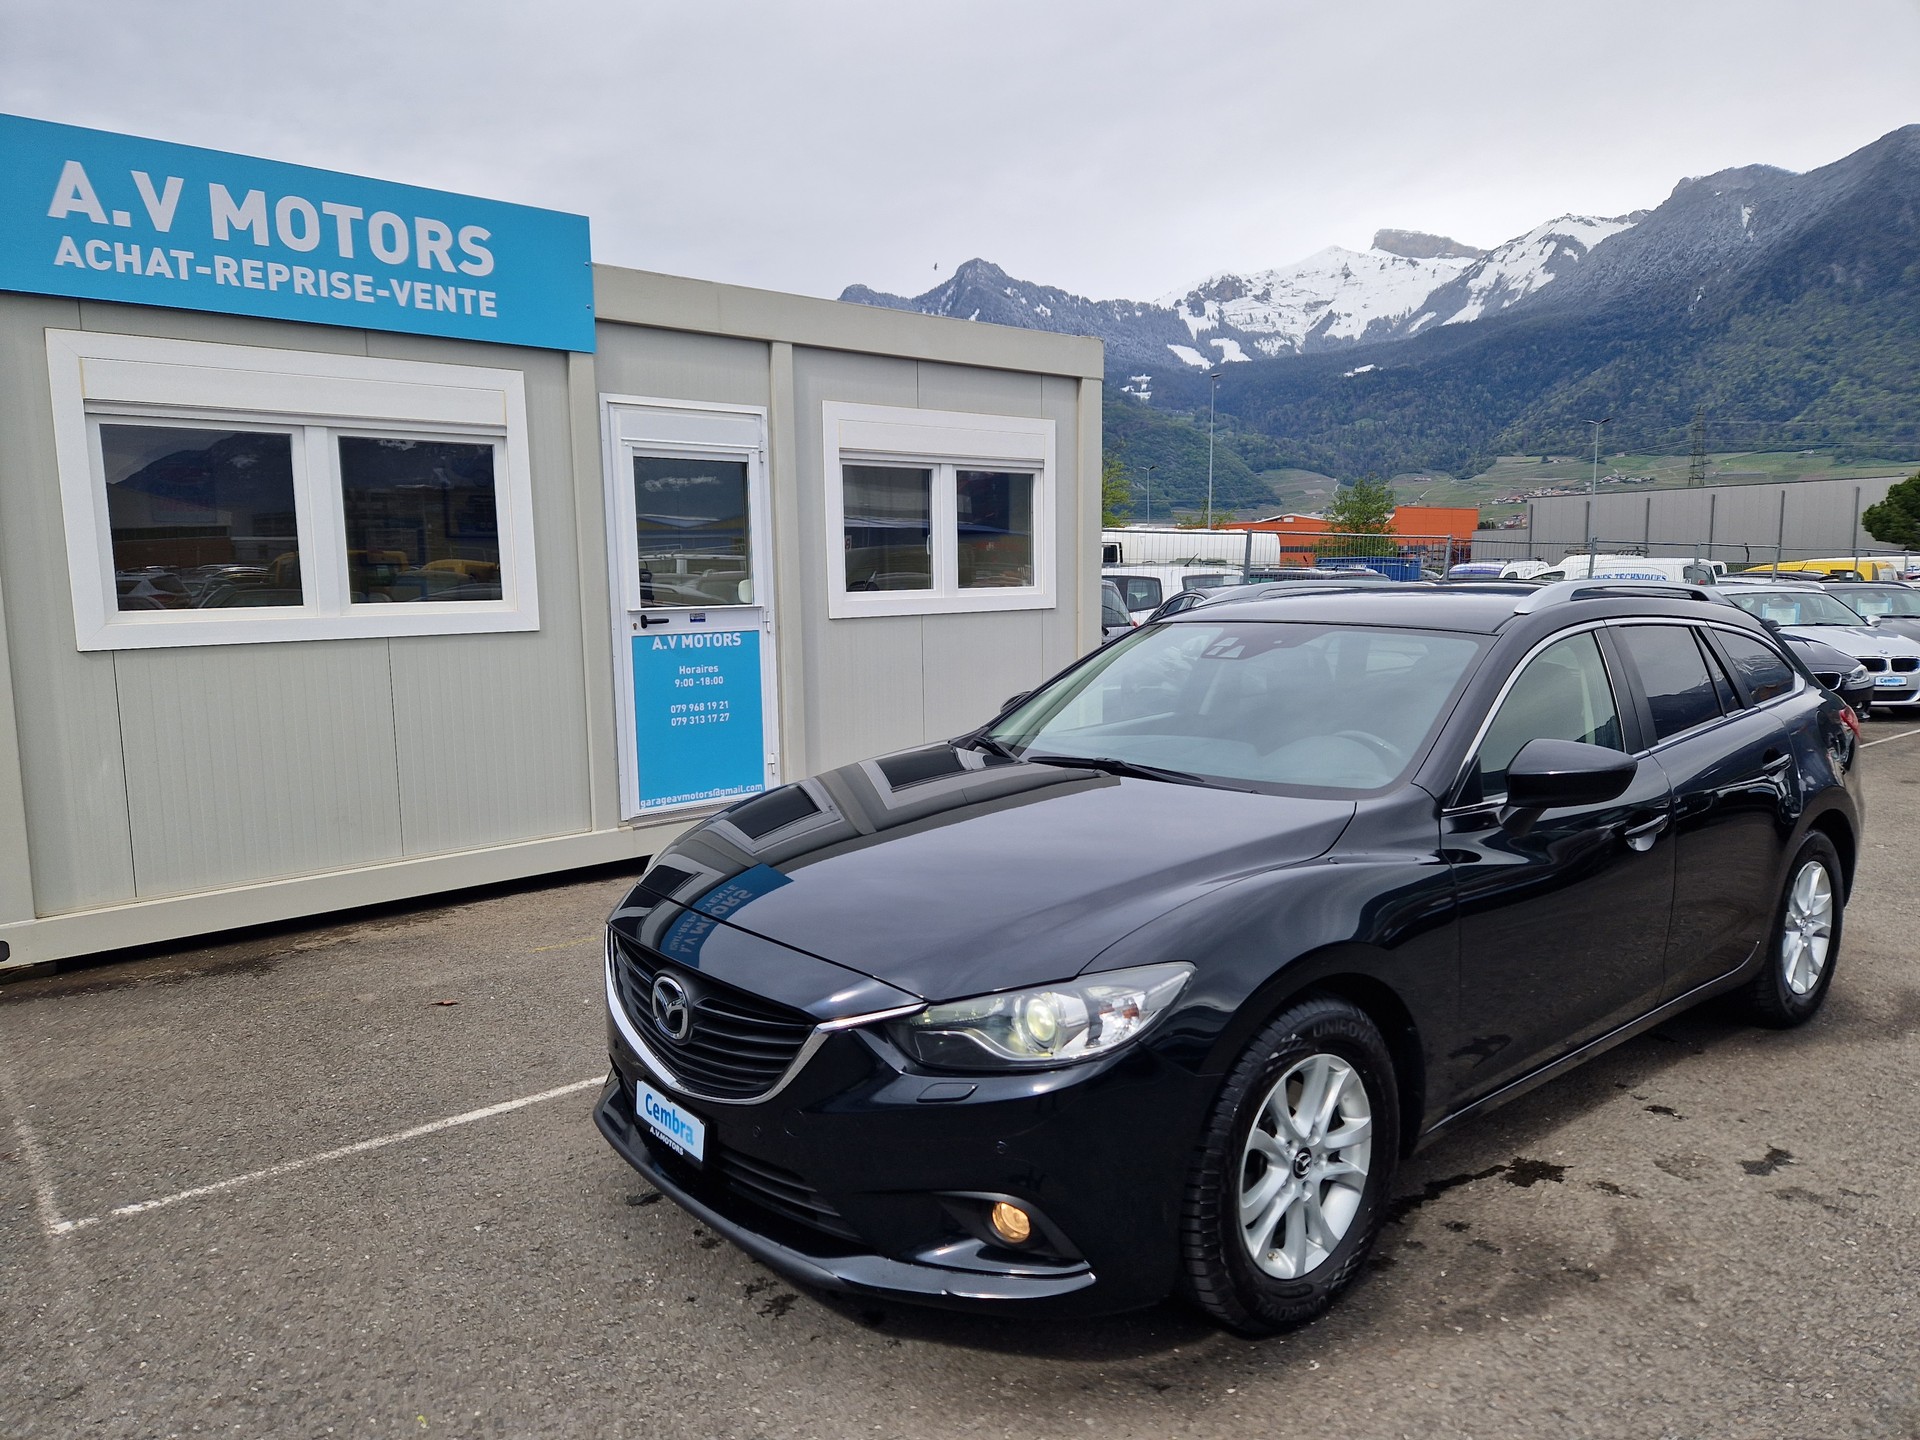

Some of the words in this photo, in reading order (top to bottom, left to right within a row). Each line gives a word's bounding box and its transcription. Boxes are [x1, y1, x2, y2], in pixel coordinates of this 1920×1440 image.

[47, 160, 184, 233] A.V
[209, 182, 495, 277] MOTORS
[54, 235, 498, 318] ACHAT-REPRISE-VENTE
[652, 636, 677, 650] A.V
[682, 633, 742, 648] MOTORS
[679, 665, 719, 674] Horaires
[674, 679, 694, 687] 9:00
[670, 704, 686, 714] 079
[689, 702, 705, 712] 968
[707, 702, 717, 711] 19
[719, 701, 729, 710] 21
[671, 717, 687, 727] 079
[689, 715, 705, 725] 313
[708, 714, 718, 723] 17
[719, 713, 730, 722] 27
[640, 782, 763, 809] garageavmotors@gmail.com
[645, 1093, 695, 1146] Cembra
